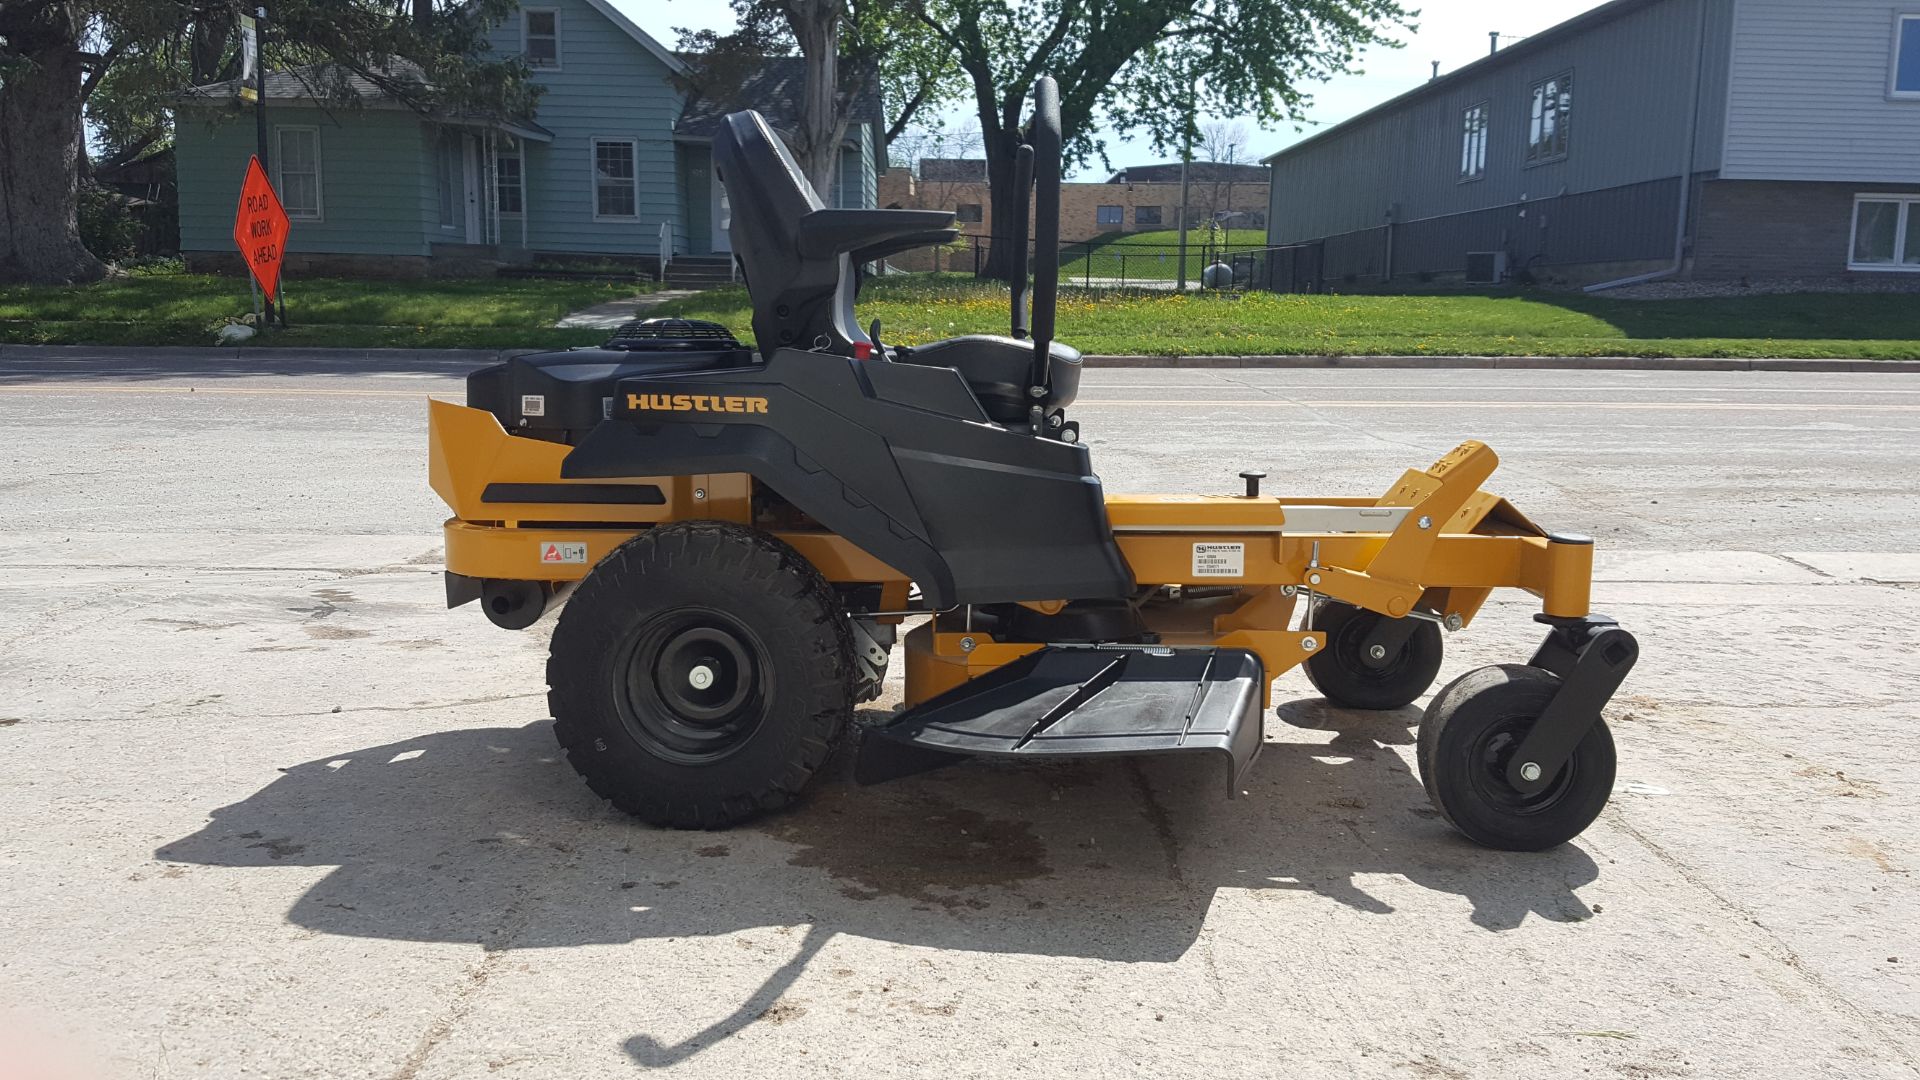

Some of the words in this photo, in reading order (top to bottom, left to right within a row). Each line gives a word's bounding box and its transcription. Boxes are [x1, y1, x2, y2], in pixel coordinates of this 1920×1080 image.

[247, 194, 269, 213] ROAD
[250, 219, 272, 239] WORK
[253, 244, 277, 265] AHEAD
[627, 393, 769, 414] HUSTLER
